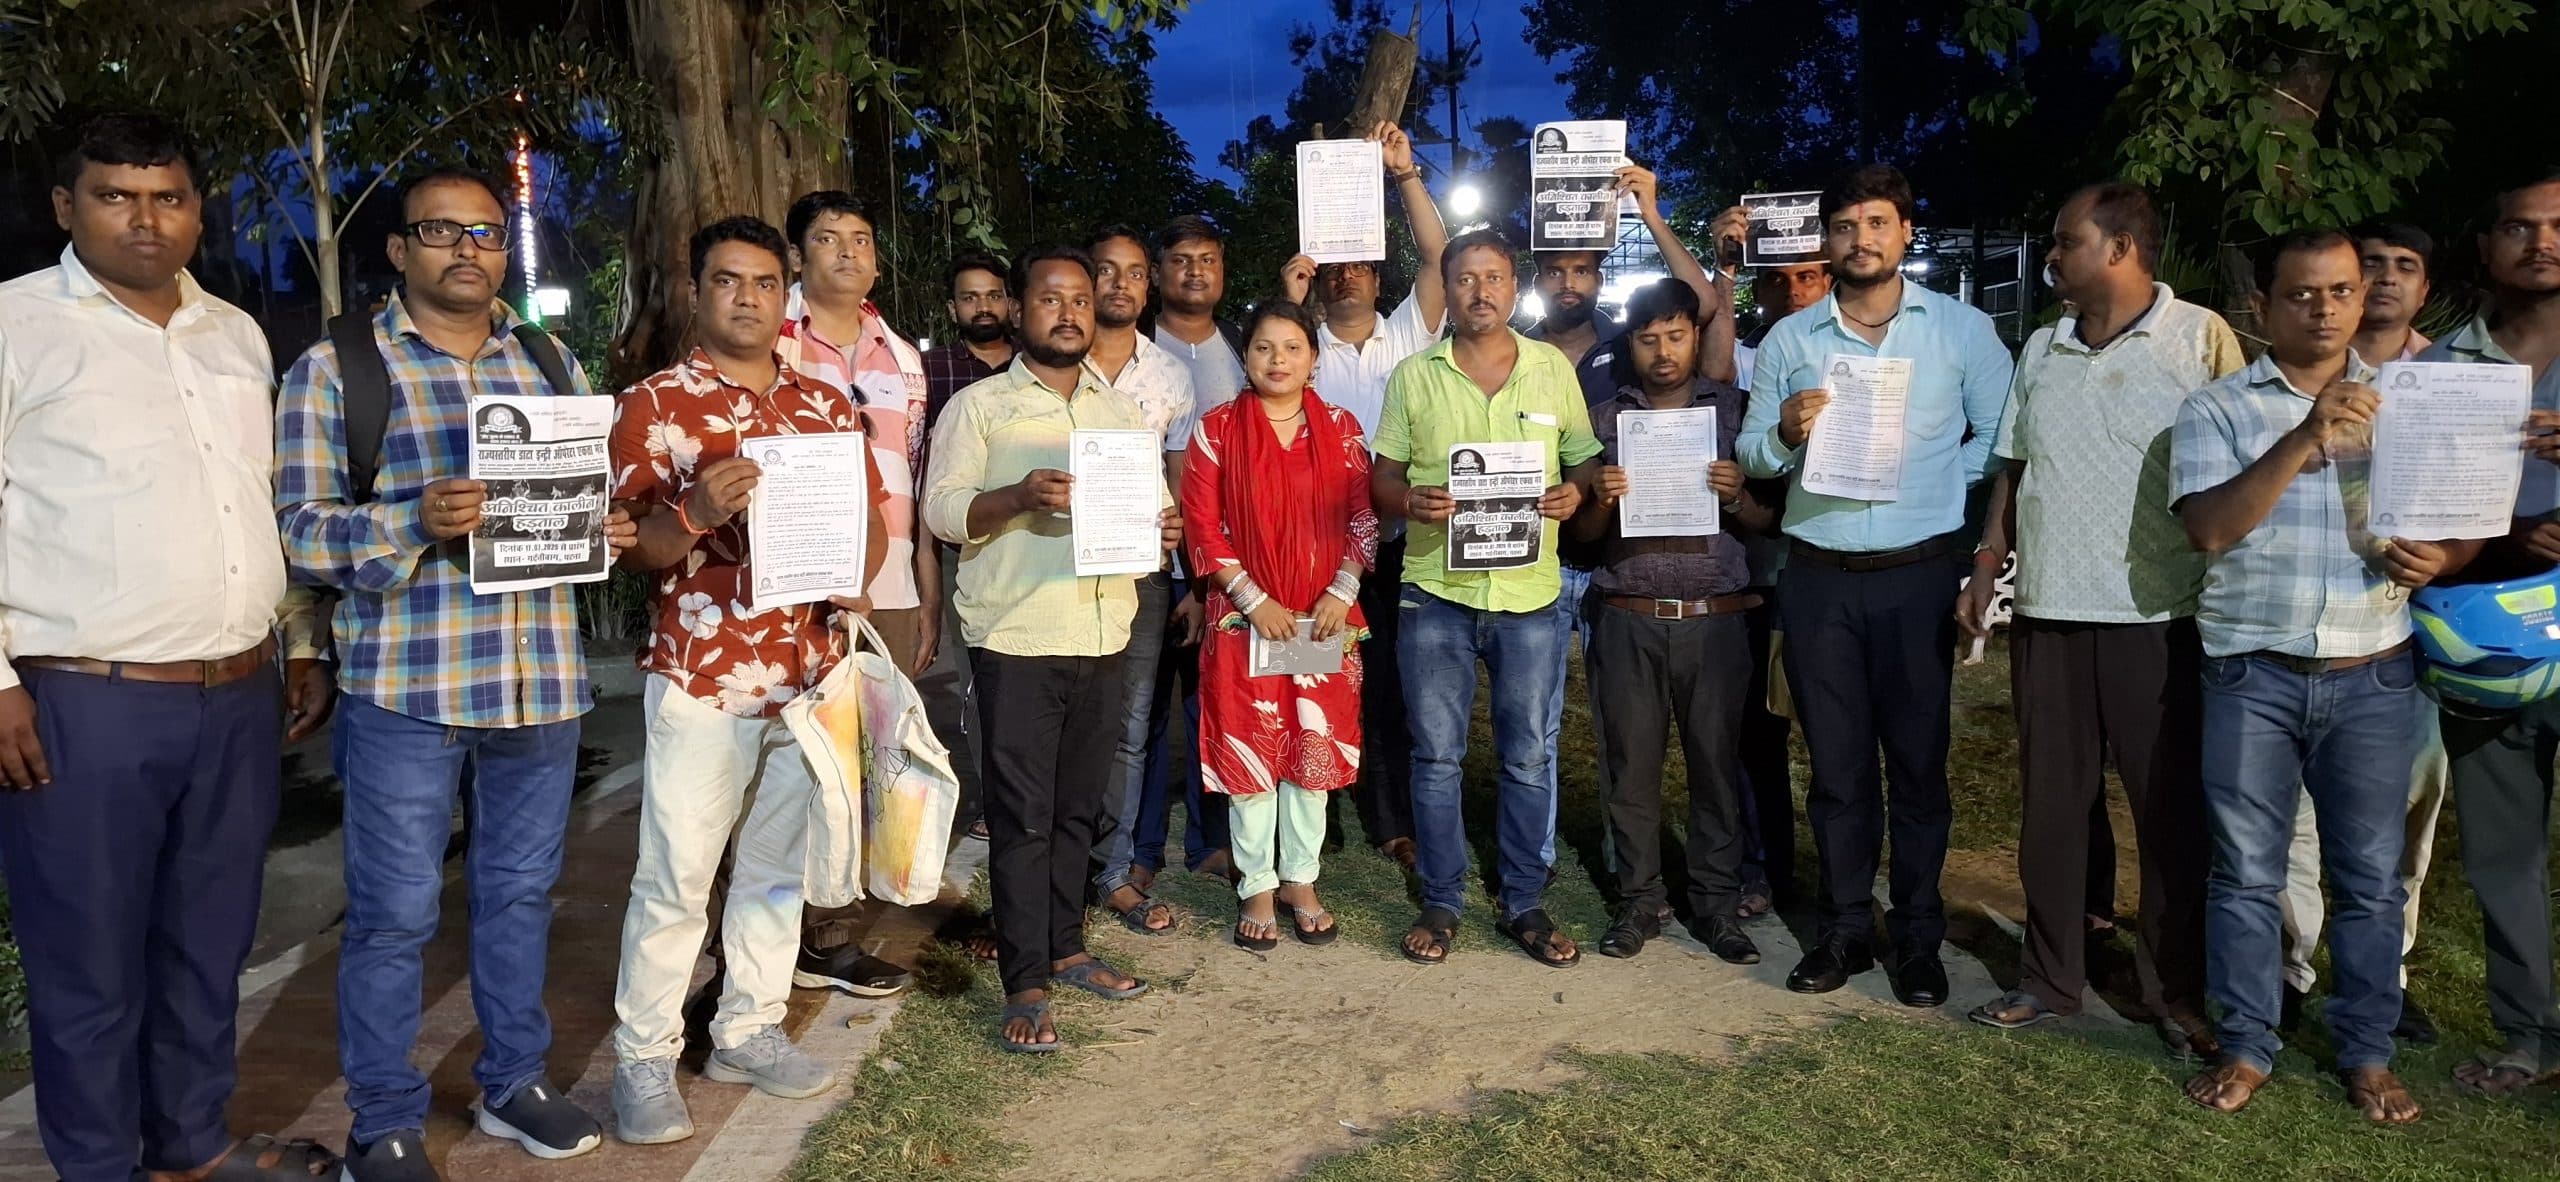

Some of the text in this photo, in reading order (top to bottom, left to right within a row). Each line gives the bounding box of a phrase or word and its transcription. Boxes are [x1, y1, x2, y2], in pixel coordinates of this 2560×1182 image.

[1792, 205, 1817, 215] काली
[519, 449, 533, 460] डाटा
[576, 445, 593, 457] एकता
[483, 496, 595, 513] अनिश्चित कालीन
[515, 518, 566, 531] हड़ताल
